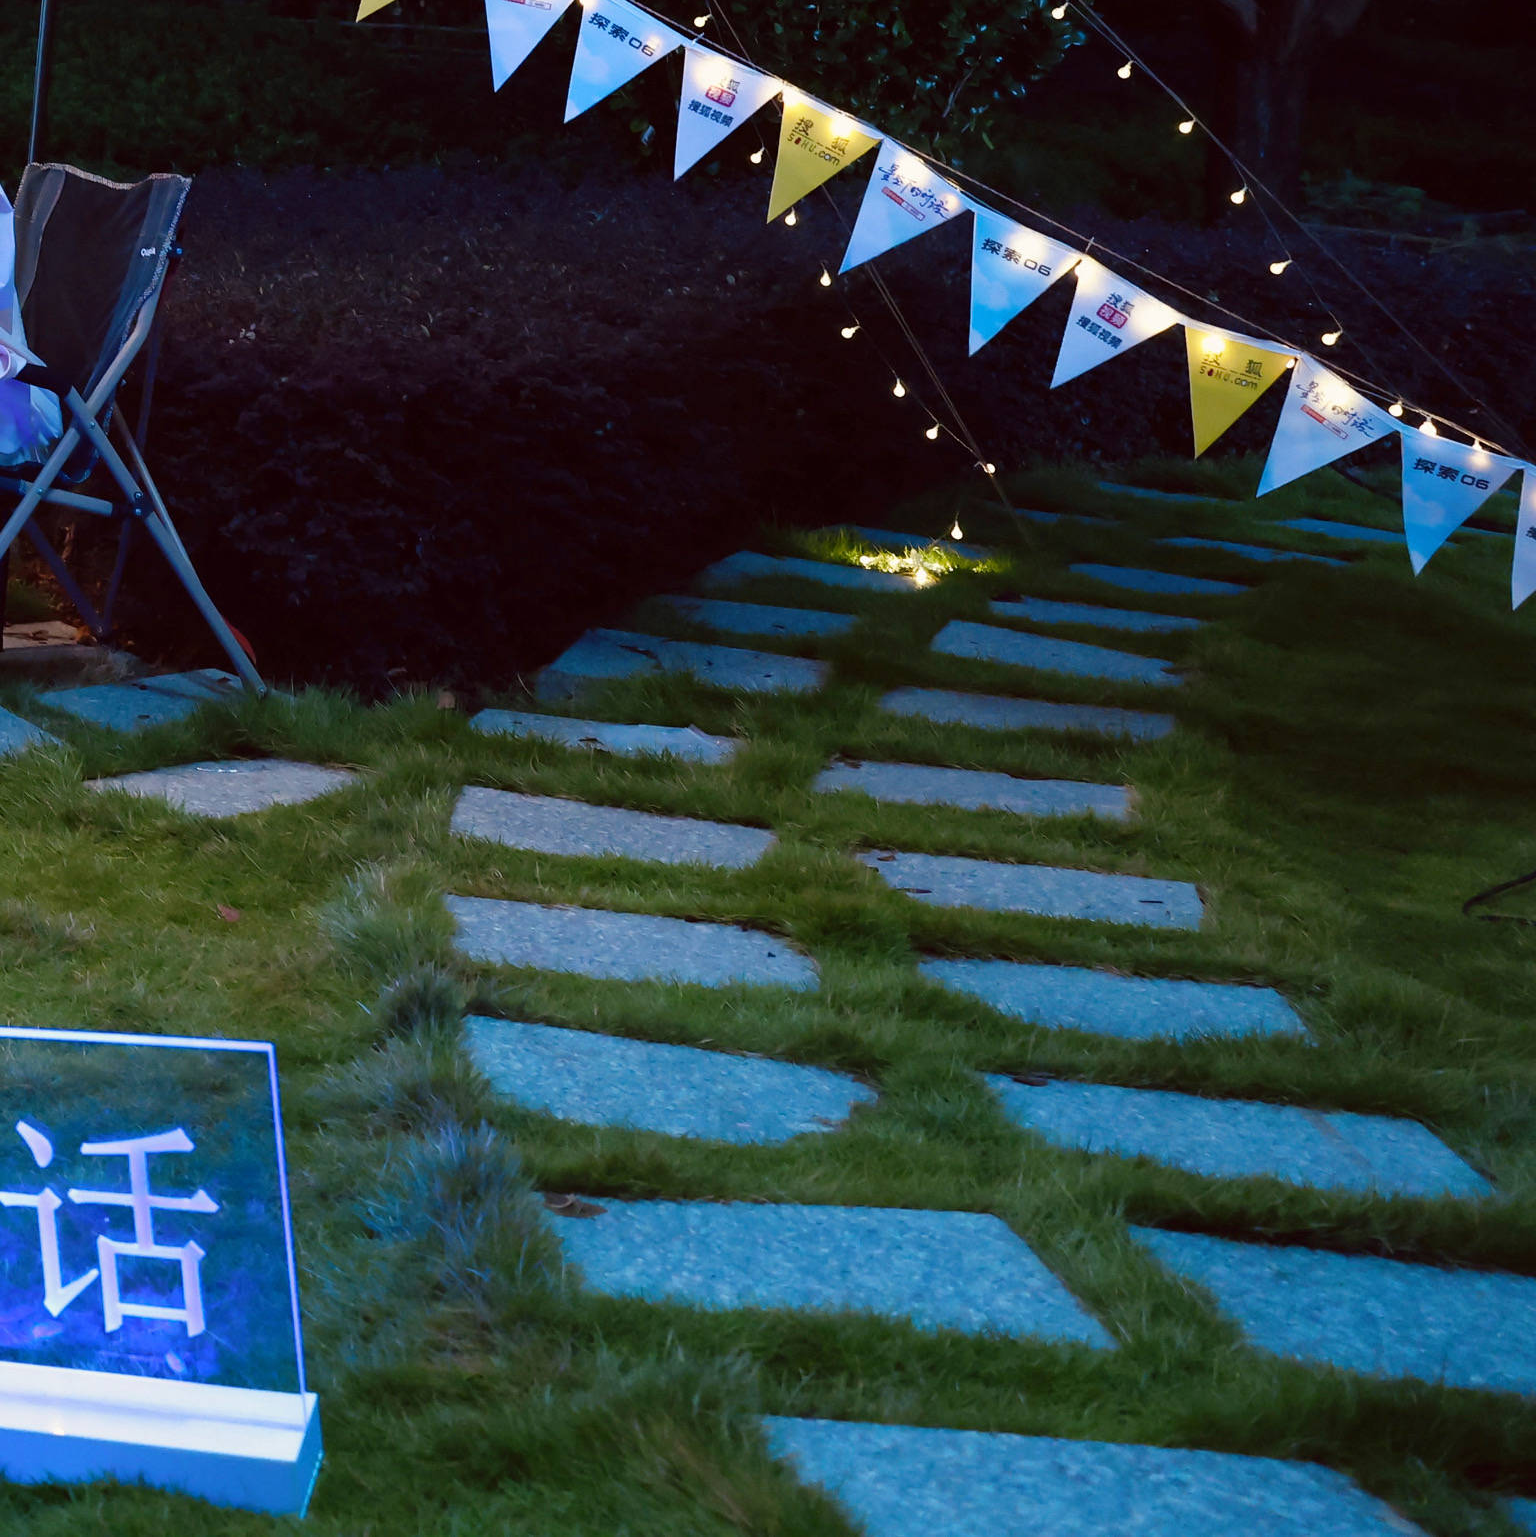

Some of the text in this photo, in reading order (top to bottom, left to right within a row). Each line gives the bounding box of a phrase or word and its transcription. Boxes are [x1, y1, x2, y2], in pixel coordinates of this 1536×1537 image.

[589, 12, 655, 57] 探索06
[688, 99, 734, 127] 搜狐视频
[981, 238, 1051, 277] 探索06
[1076, 315, 1122, 349] 搜狐视频
[1413, 458, 1490, 490] 探索06
